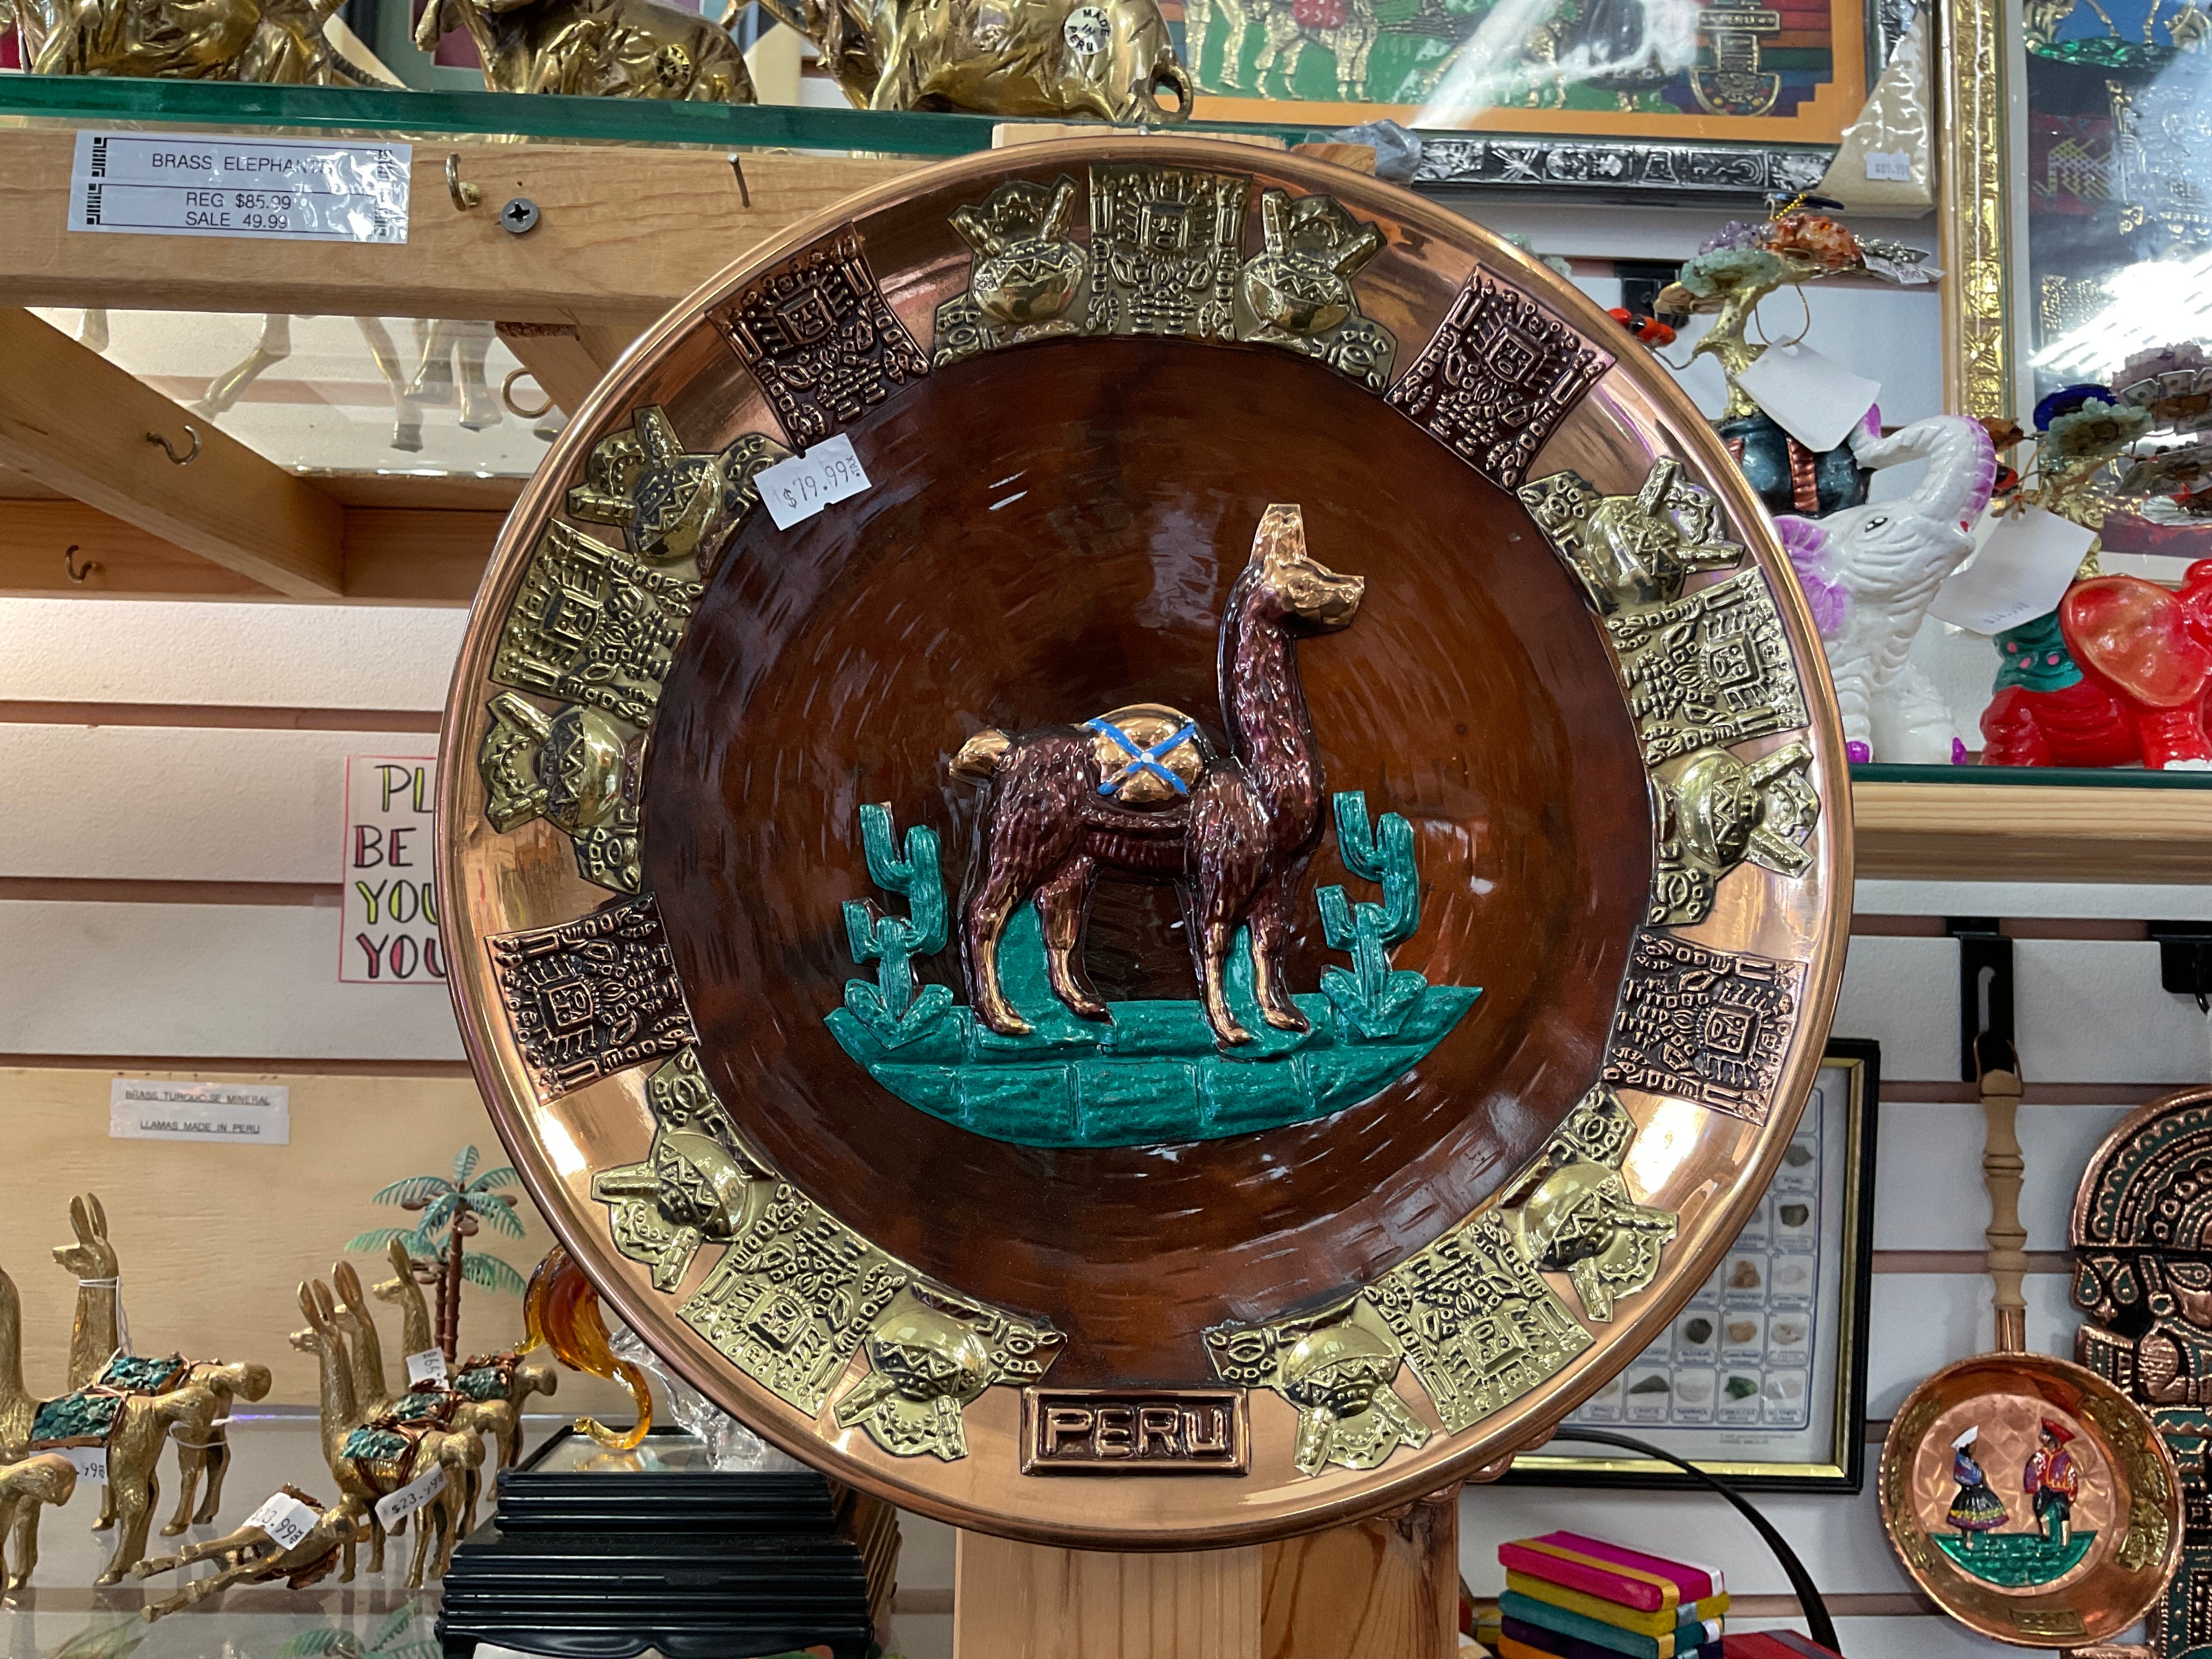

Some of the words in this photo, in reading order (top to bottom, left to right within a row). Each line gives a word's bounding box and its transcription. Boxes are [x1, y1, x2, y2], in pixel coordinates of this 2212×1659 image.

[1081, 24, 1096, 35] IN
[1082, 9, 1111, 37] MADE
[1069, 26, 1093, 52] PERU
[152, 153, 213, 169] BRASS
[186, 192, 224, 207] REG
[235, 193, 291, 210] $85.99
[185, 211, 230, 226] SALE
[243, 214, 287, 229] 49.99
[783, 461, 849, 509] $79.99
[374, 764, 433, 813] PL
[353, 824, 417, 868] BE
[140, 1120, 178, 1131] LLAMAS
[184, 1122, 211, 1132] MADE
[217, 1124, 227, 1133] IN
[232, 1124, 260, 1134] PERU
[1045, 1403, 1227, 1457] PERU
